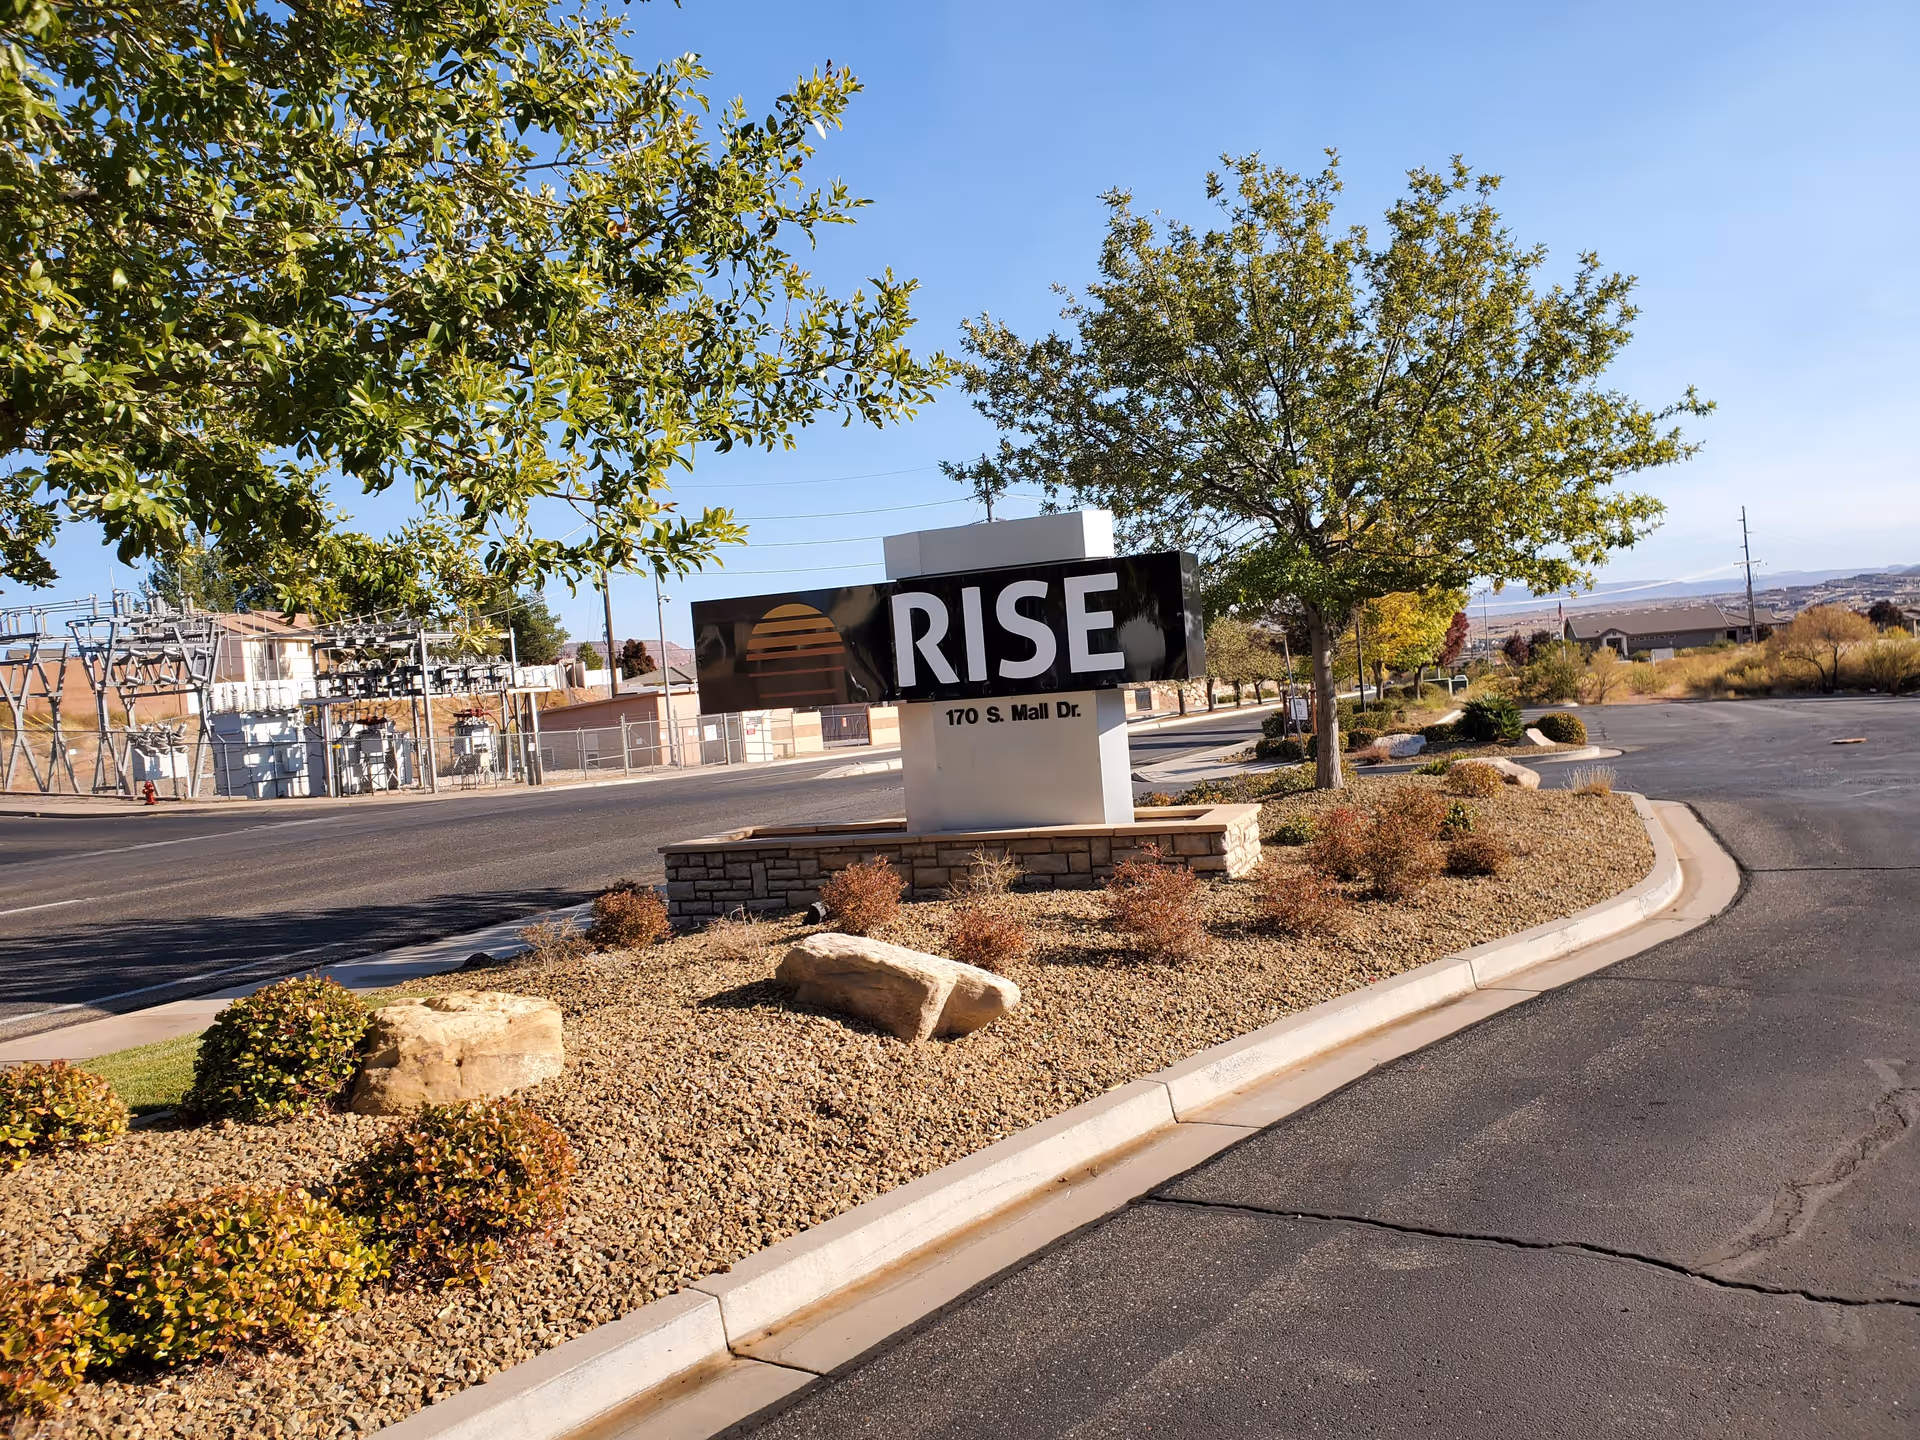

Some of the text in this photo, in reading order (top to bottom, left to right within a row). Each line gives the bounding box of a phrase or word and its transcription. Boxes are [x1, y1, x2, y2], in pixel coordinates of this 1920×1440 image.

[891, 572, 1125, 687] RISE
[946, 701, 1081, 726] 170 S. Mall Dr.
